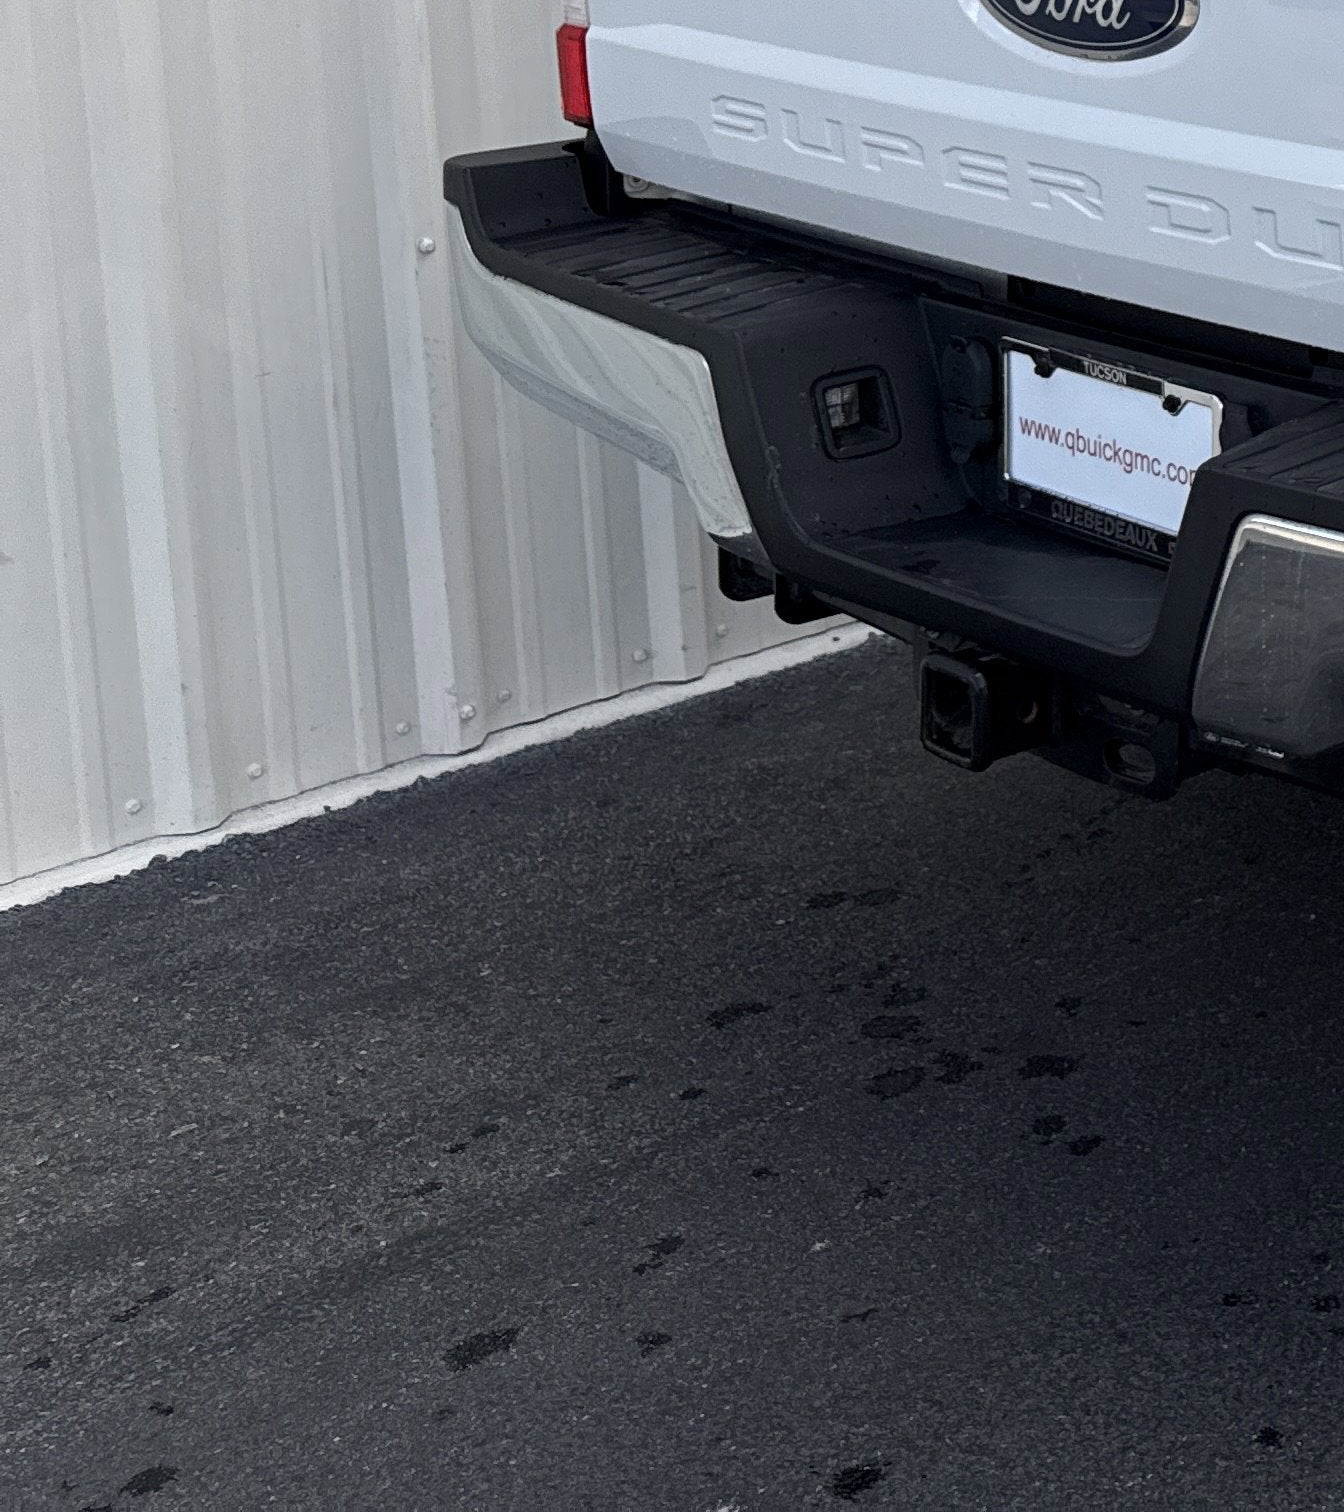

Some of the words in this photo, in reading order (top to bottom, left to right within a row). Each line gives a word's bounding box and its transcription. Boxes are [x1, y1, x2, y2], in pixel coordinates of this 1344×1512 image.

[710, 94, 1104, 221] SUPER
[1083, 361, 1127, 385] TUCSON
[1051, 499, 1158, 551] QUEBEDEAUX
